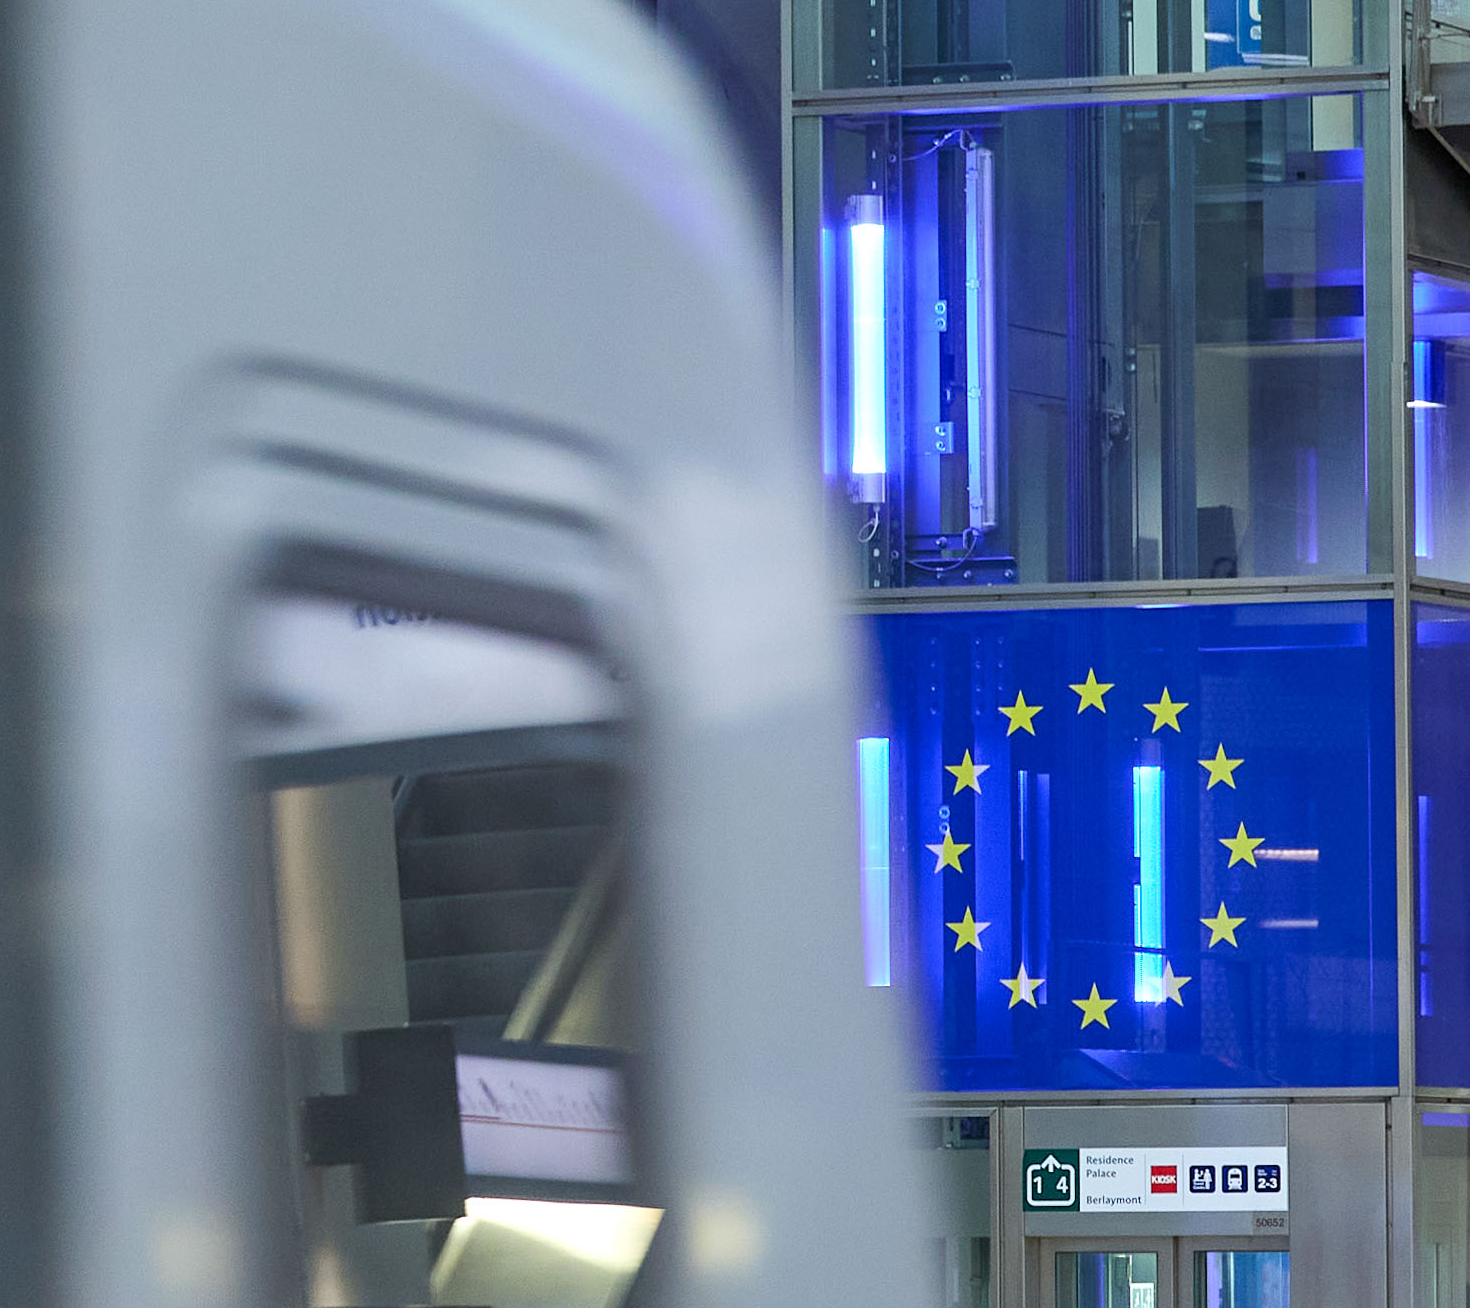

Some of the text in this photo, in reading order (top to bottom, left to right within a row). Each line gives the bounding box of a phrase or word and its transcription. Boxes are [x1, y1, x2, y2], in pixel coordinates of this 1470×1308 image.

[1086, 1156, 1134, 1165] Residence
[1086, 1169, 1117, 1178] Palace
[1151, 1175, 1176, 1184] KIOSK
[1257, 1178, 1278, 1189] 2-3
[1033, 1176, 1069, 1194] 1 4
[1086, 1196, 1142, 1206] Berlaymont
